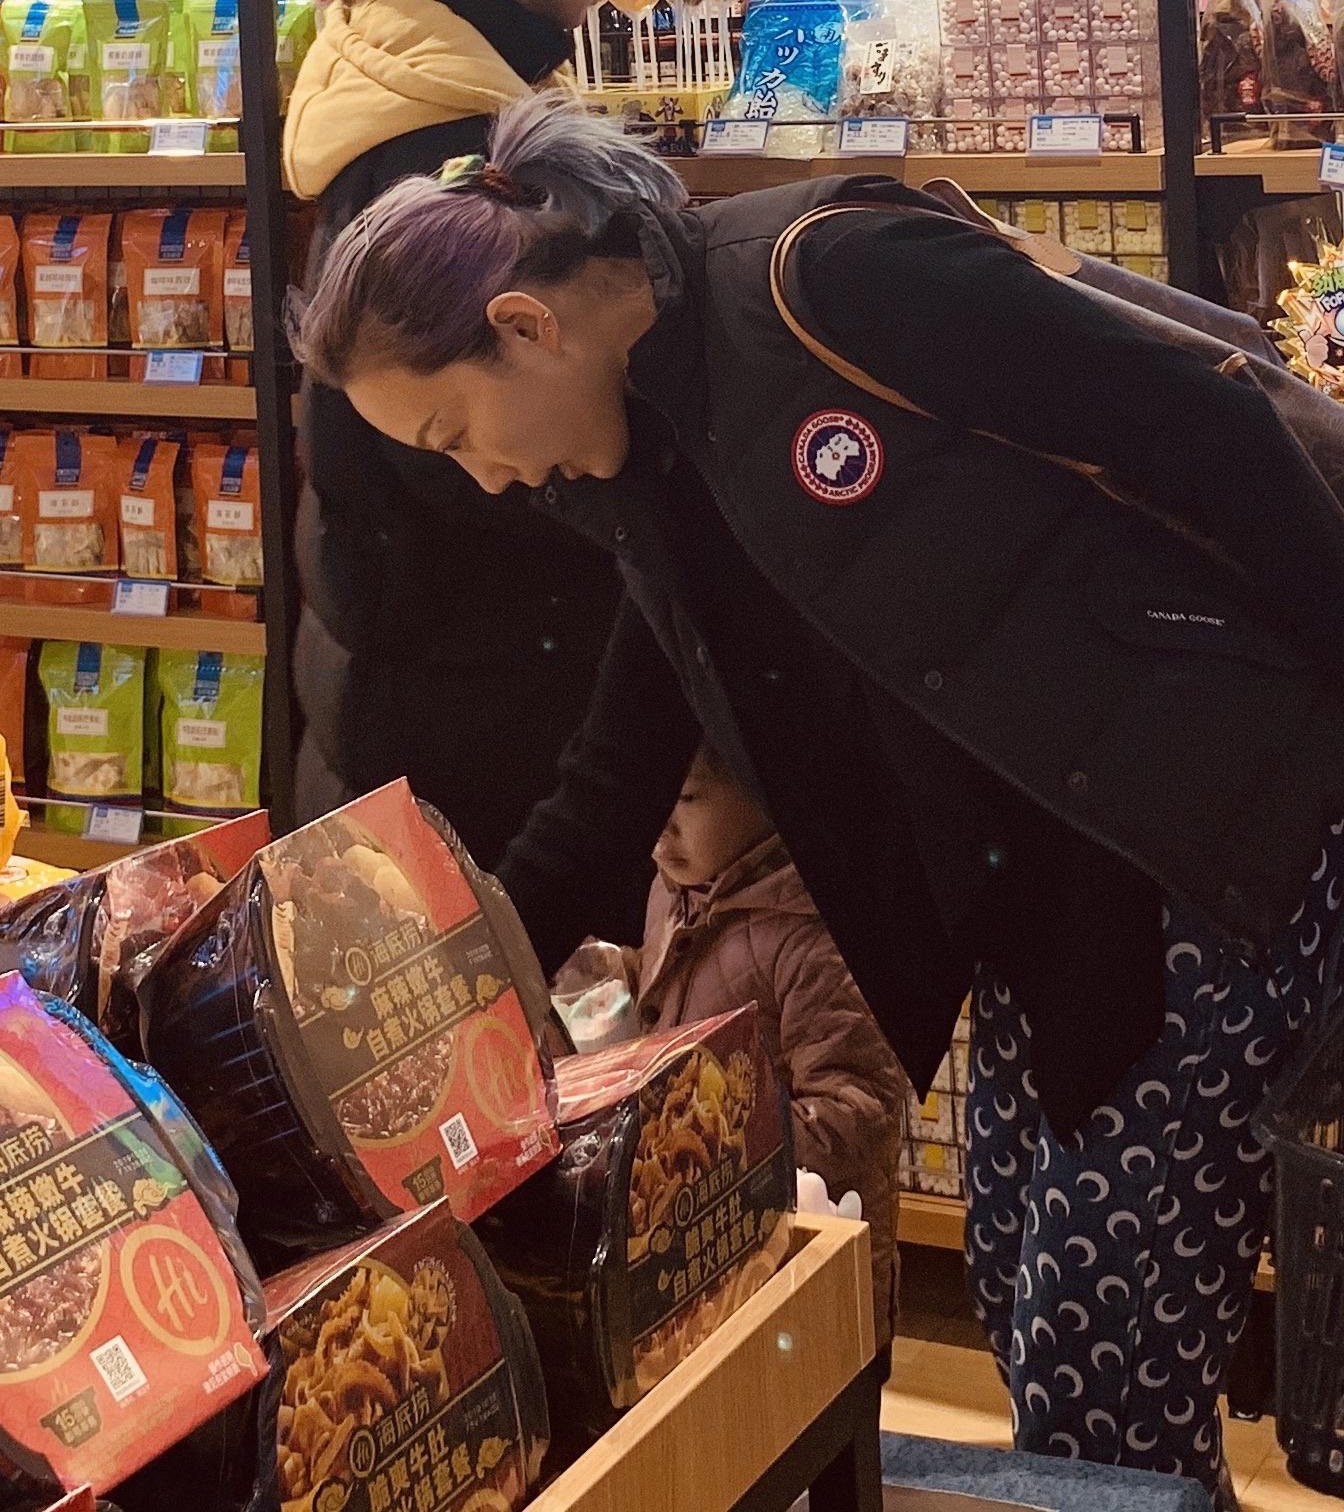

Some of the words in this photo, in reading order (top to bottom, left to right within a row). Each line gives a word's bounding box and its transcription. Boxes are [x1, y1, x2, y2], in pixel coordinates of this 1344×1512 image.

[798, 429, 812, 464] CANADA
[828, 486, 859, 498] ARCTIC
[1146, 609, 1186, 623] CANADA
[369, 922, 423, 968] 海底捞
[370, 955, 444, 1020] 麻辣嫩牛
[366, 974, 473, 1062] 自煮火锅套餐
[375, 1388, 431, 1454] 海底捞
[400, 1442, 472, 1512] 火锅套餐
